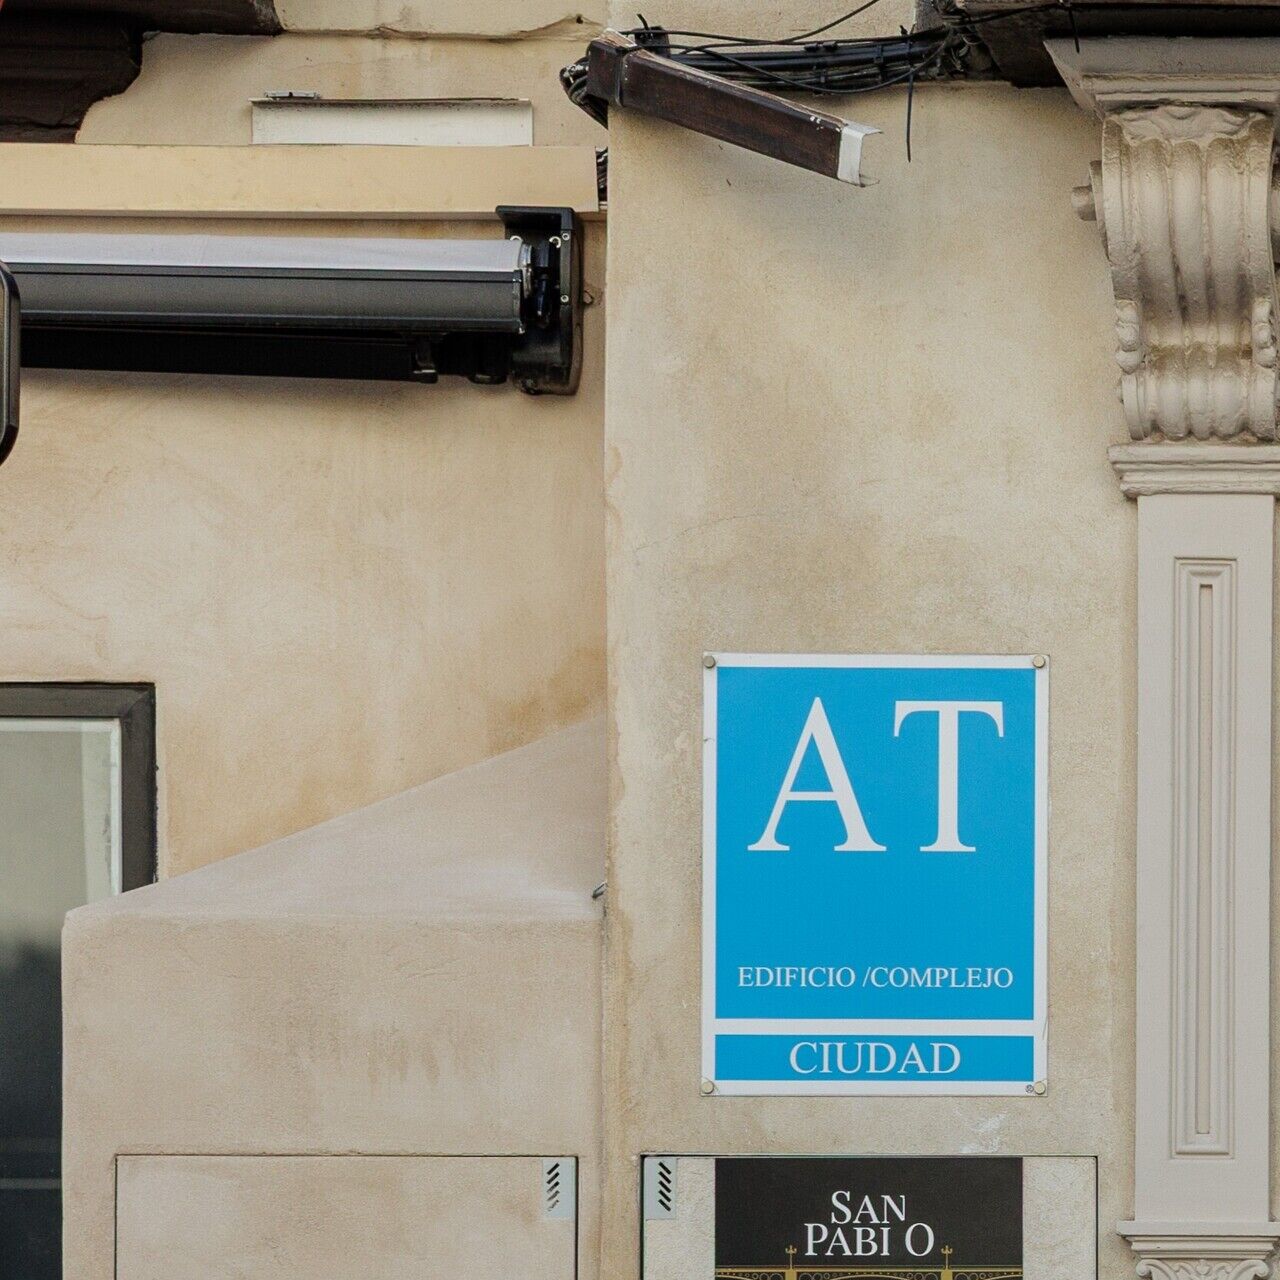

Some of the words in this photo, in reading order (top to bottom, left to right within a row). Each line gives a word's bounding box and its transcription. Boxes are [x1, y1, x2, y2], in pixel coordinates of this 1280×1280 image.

[747, 696, 1005, 853] AT
[738, 966, 856, 988] EDIFICIO
[789, 1041, 961, 1075] CIUDAD
[830, 1190, 906, 1225] SAN
